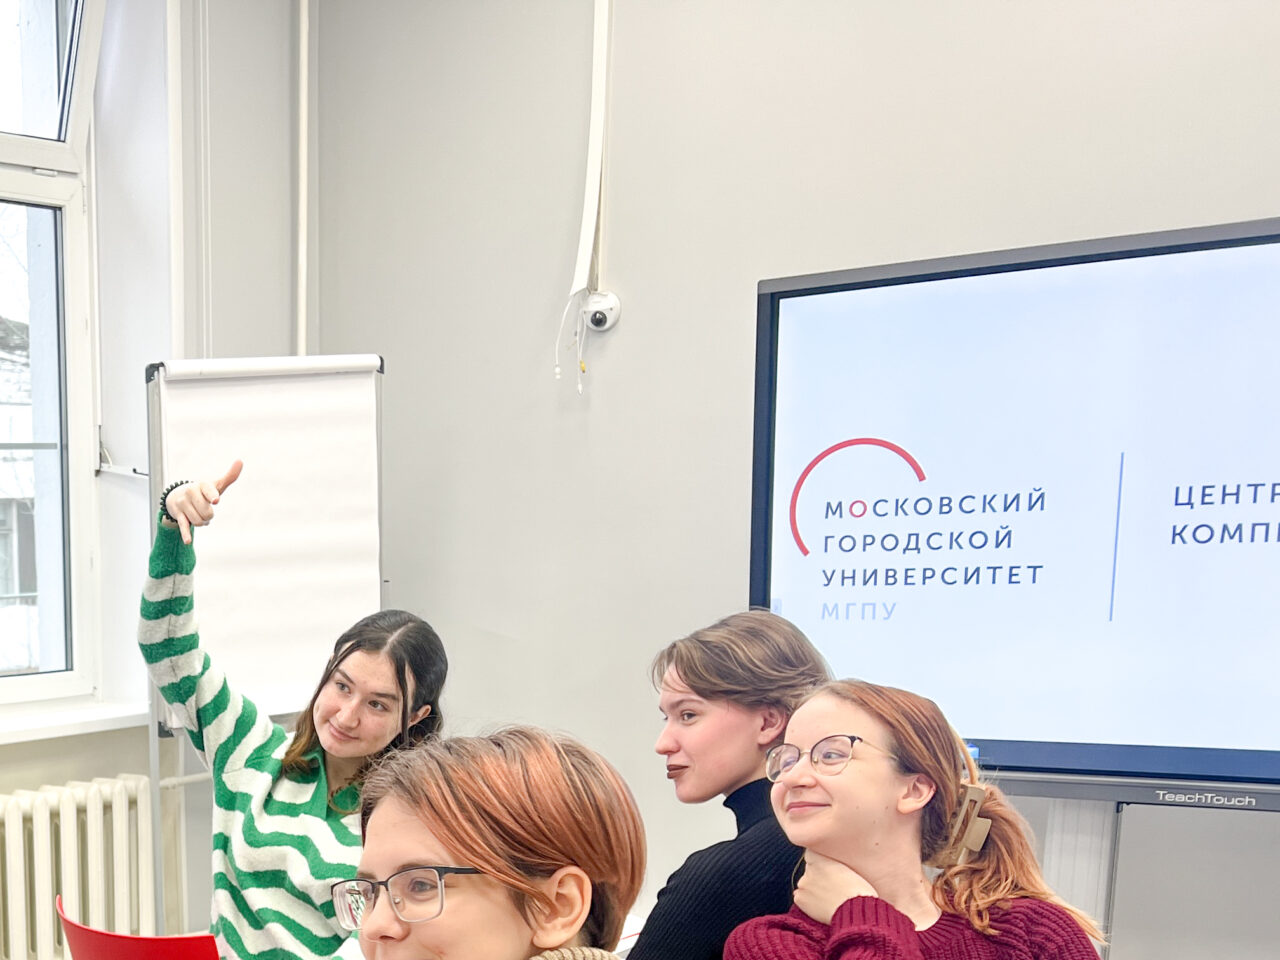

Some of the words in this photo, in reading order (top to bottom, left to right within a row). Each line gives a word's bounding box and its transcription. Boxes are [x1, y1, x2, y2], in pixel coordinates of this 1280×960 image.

[824, 487, 1046, 519] МОСКОВСКИЙ
[823, 525, 1013, 555] ГОРОДСКОЙ
[1171, 522, 1280, 545] КОМП
[822, 565, 1045, 587] УНИВЕРСИТЕТ
[821, 602, 897, 620] МГПУ
[1155, 790, 1257, 806] TeachTouch
